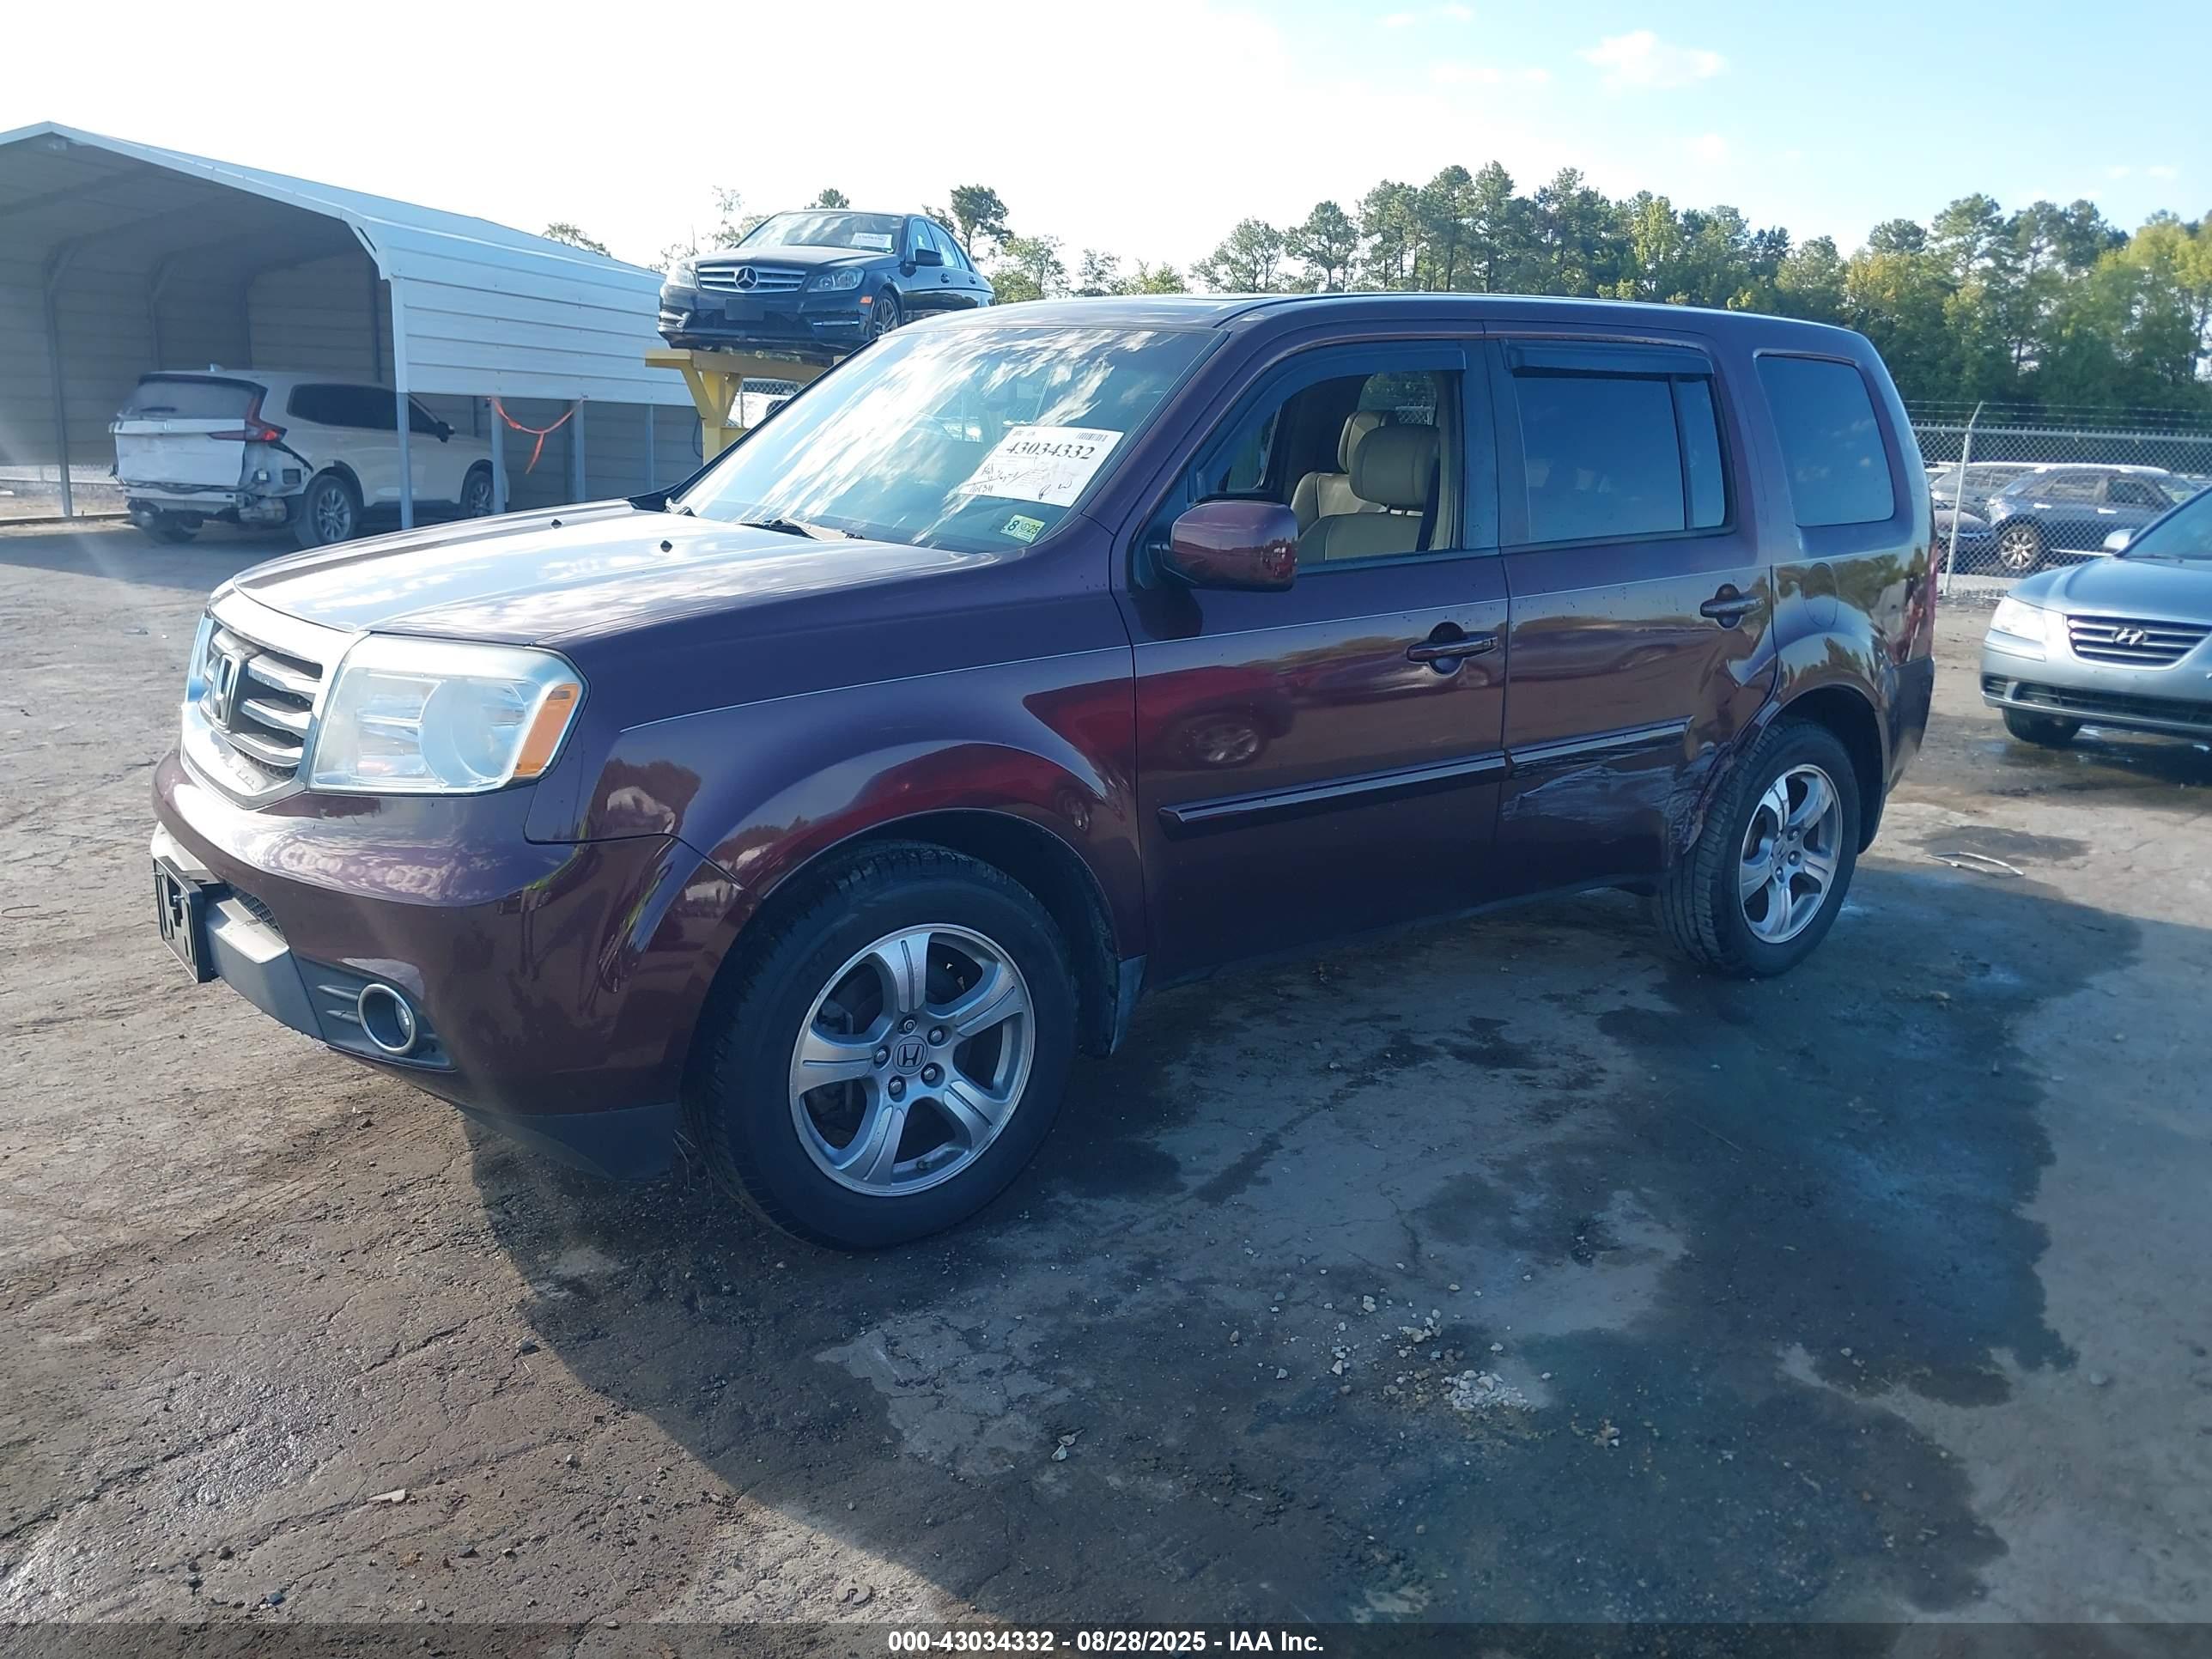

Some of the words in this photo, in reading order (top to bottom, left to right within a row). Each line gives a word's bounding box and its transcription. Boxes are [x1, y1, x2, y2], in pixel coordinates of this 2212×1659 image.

[1006, 441, 1096, 460] 43034332
[1007, 520, 1020, 532] 8
[1026, 524, 1041, 535] 25
